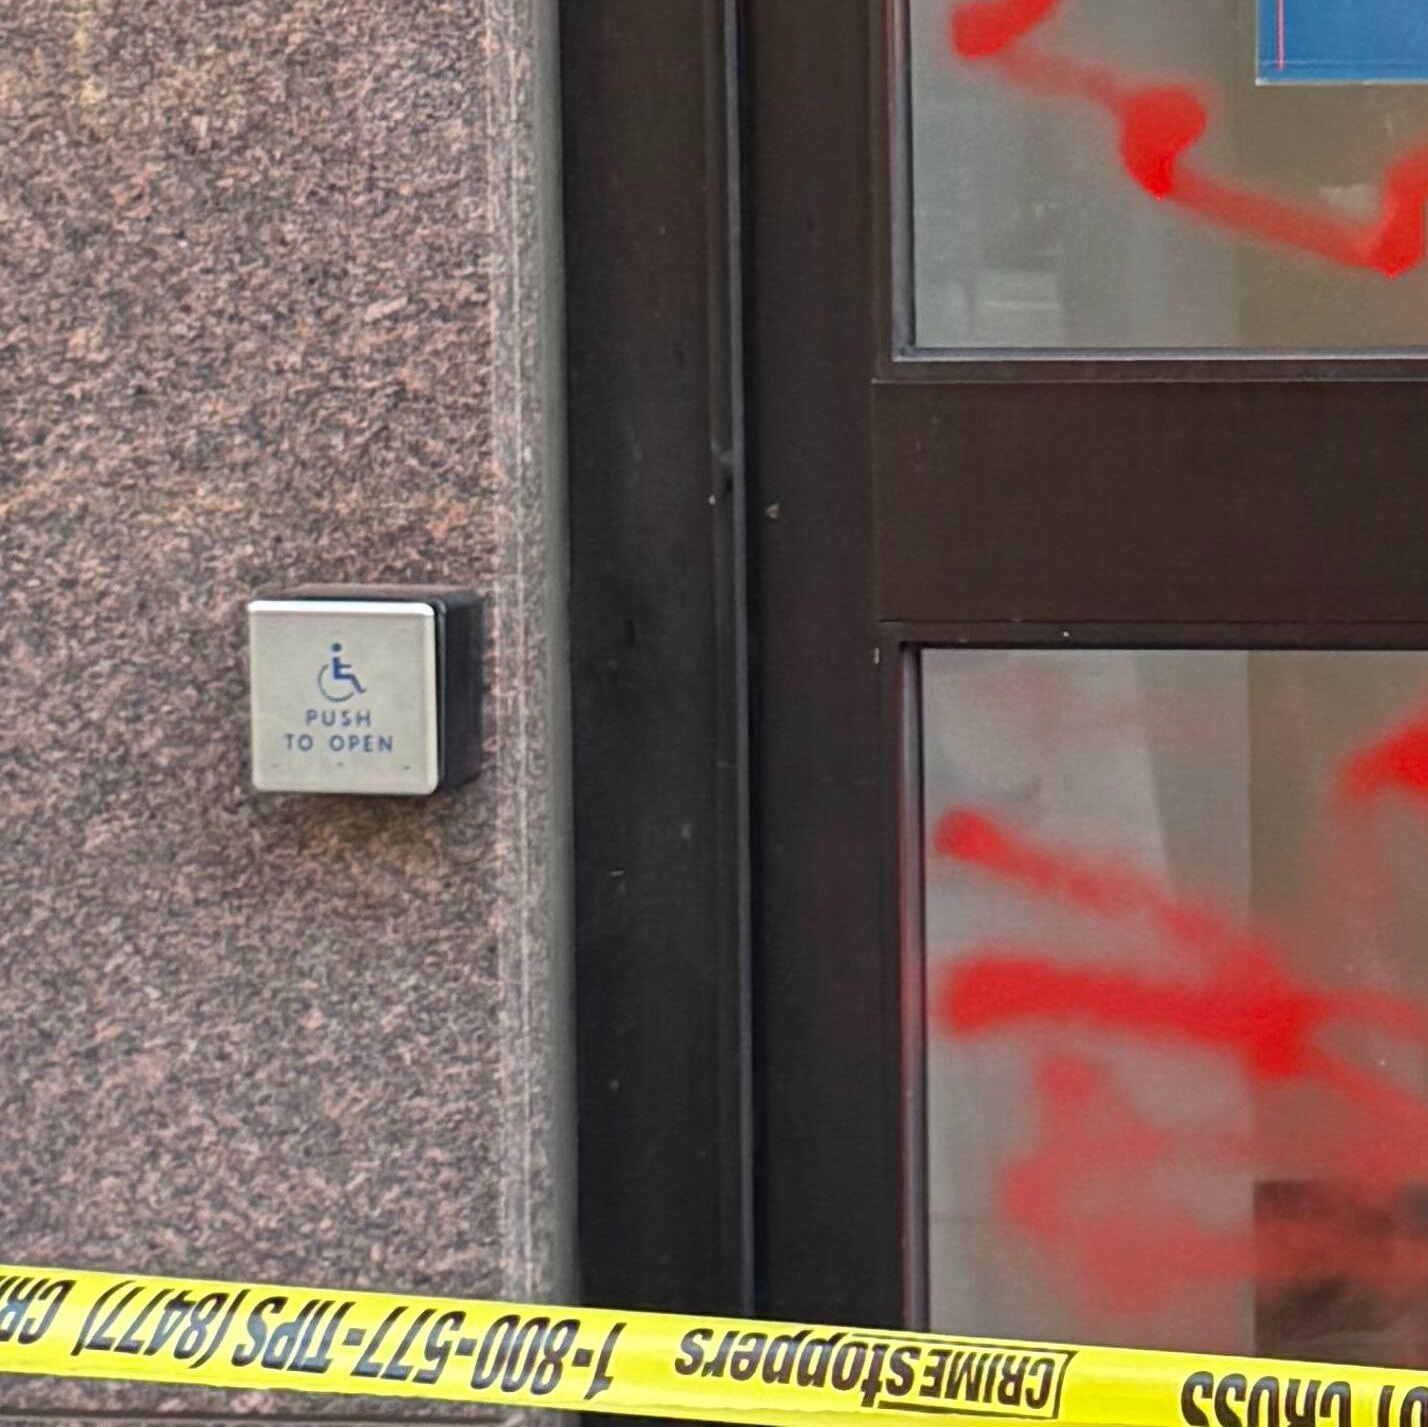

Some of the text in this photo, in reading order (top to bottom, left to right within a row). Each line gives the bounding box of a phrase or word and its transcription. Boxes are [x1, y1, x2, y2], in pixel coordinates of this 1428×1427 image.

[284, 733, 393, 752] TO OPEN
[305, 709, 371, 727] PUSH
[70, 1279, 252, 1370] (8477)
[231, 1296, 627, 1400] 1-800-577-TIPS
